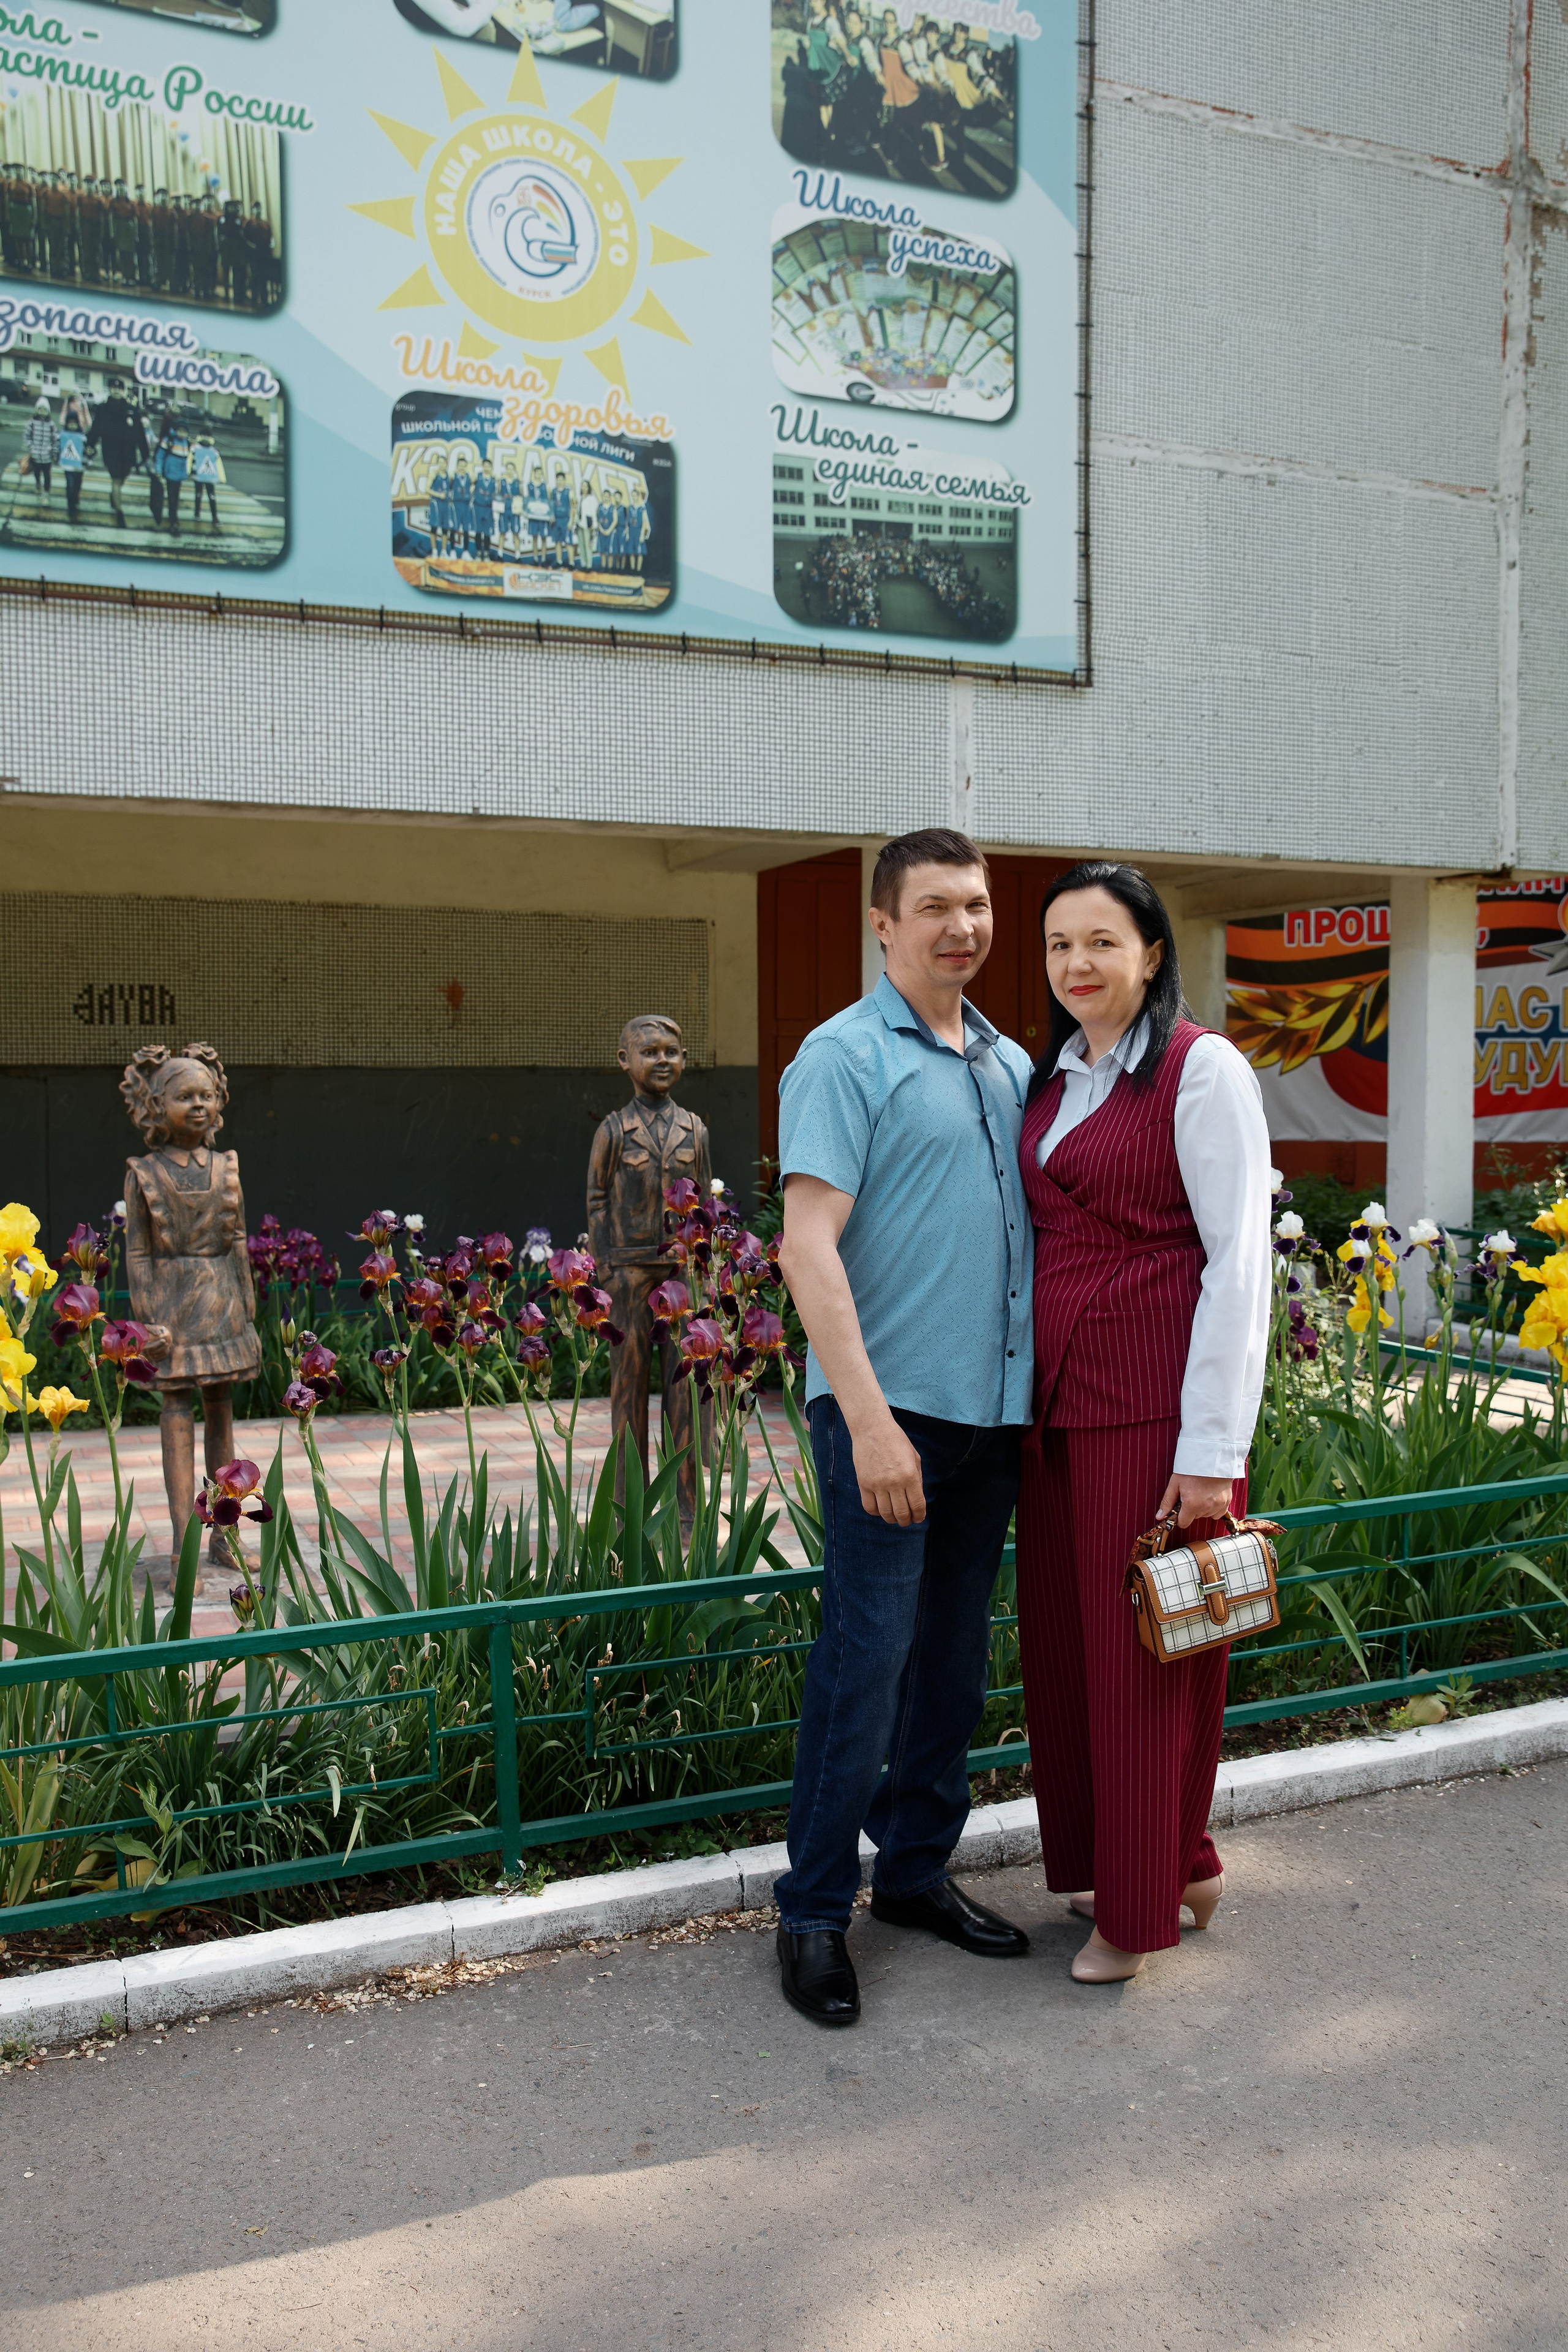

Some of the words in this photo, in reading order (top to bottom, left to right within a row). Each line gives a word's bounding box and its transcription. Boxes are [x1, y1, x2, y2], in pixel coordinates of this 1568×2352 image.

[164, 66, 313, 130] России
[436, 143, 482, 236] НАША
[481, 124, 595, 179] ШКОЛА
[602, 200, 630, 266] ЭТО
[794, 170, 920, 227] Школа
[891, 233, 997, 272] успеха
[139, 354, 275, 394] школа
[394, 335, 544, 393] Школа
[401, 419, 481, 434] ШКОЛЬНОЙ
[501, 391, 673, 445] здоровья
[771, 404, 899, 456] Школа
[600, 442, 636, 462] ЛИГИ
[819, 459, 927, 498] единая
[936, 474, 1031, 505] семья
[1474, 1041, 1568, 1091] УДУ
